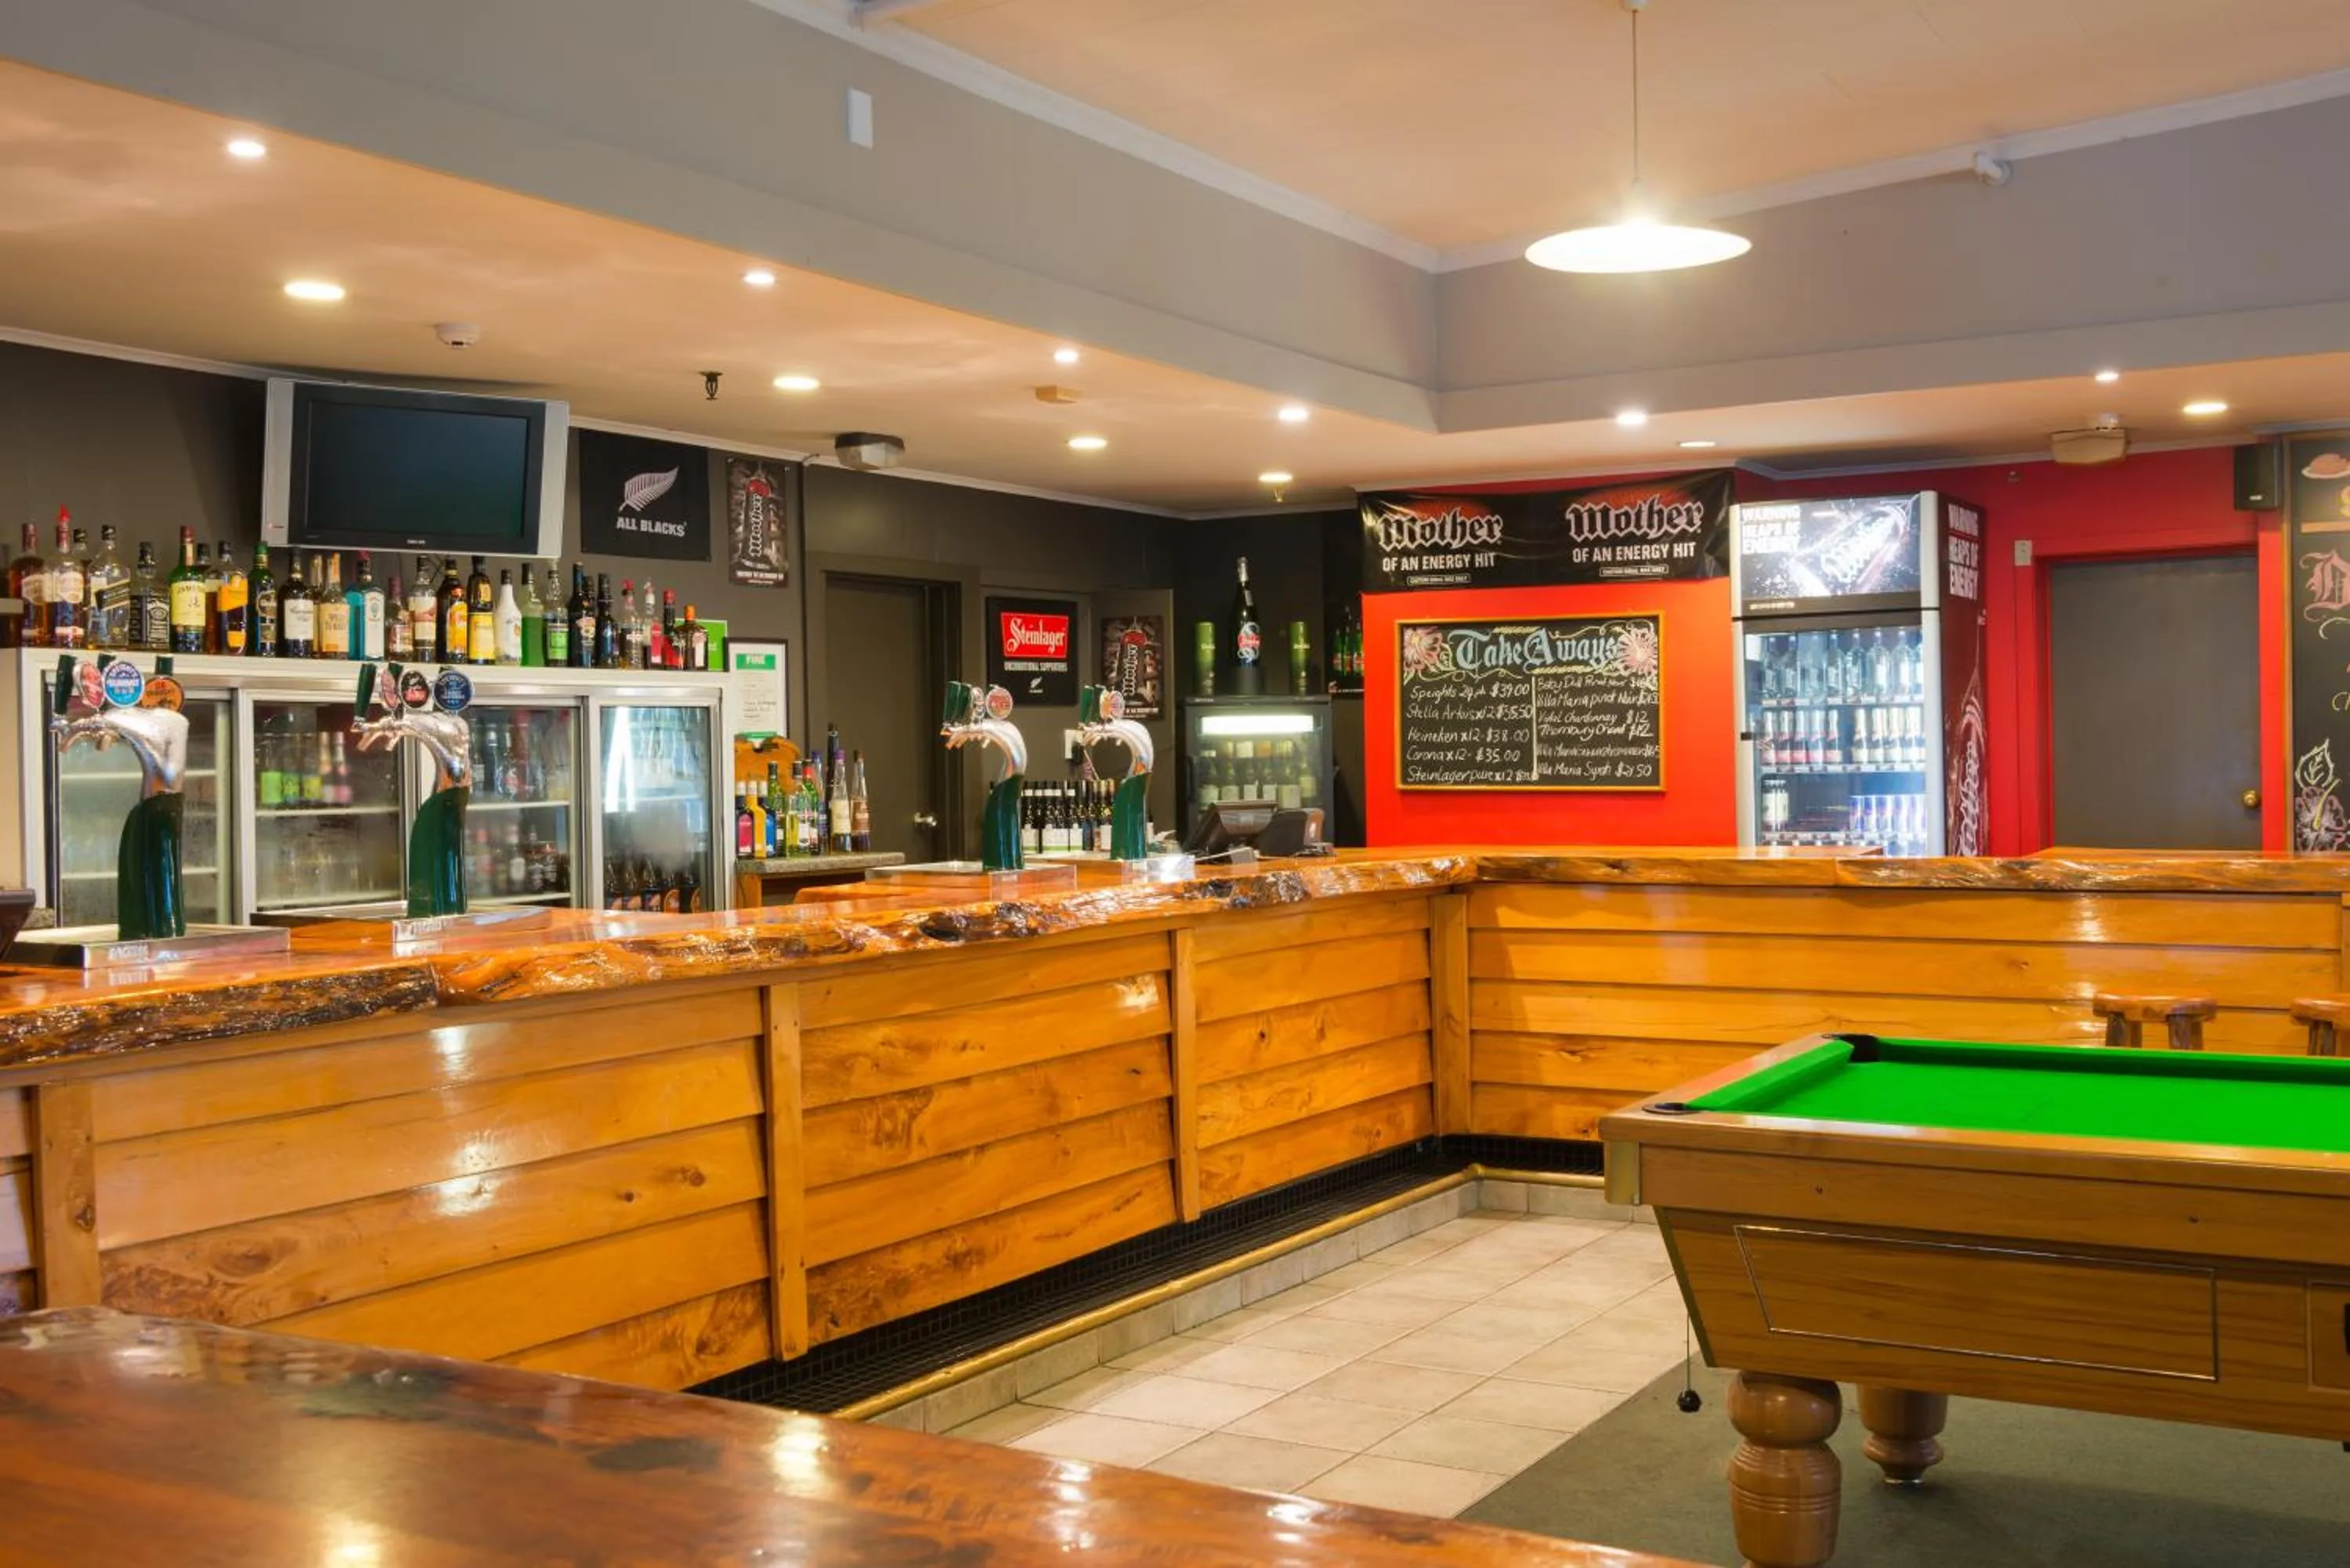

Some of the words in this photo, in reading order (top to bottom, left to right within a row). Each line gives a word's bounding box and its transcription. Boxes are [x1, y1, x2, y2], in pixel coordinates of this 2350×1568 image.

[616, 517, 638, 530] ALL
[640, 519, 686, 538] BLACKS
[1376, 507, 1504, 552] Mother
[1564, 493, 1705, 544] Mother
[1382, 557, 1398, 572] OF
[1401, 555, 1419, 571] AN
[1422, 554, 1471, 570] ENERGY
[1474, 552, 1496, 568] HIT
[1572, 548, 1590, 563] OF
[1592, 547, 1612, 562] AN
[1615, 543, 1670, 561] ENERGY
[1672, 541, 1697, 558] HIT
[1006, 616, 1066, 654] Steinlager
[1123, 643, 1139, 696] Mother
[1407, 726, 1459, 743] Heineken
